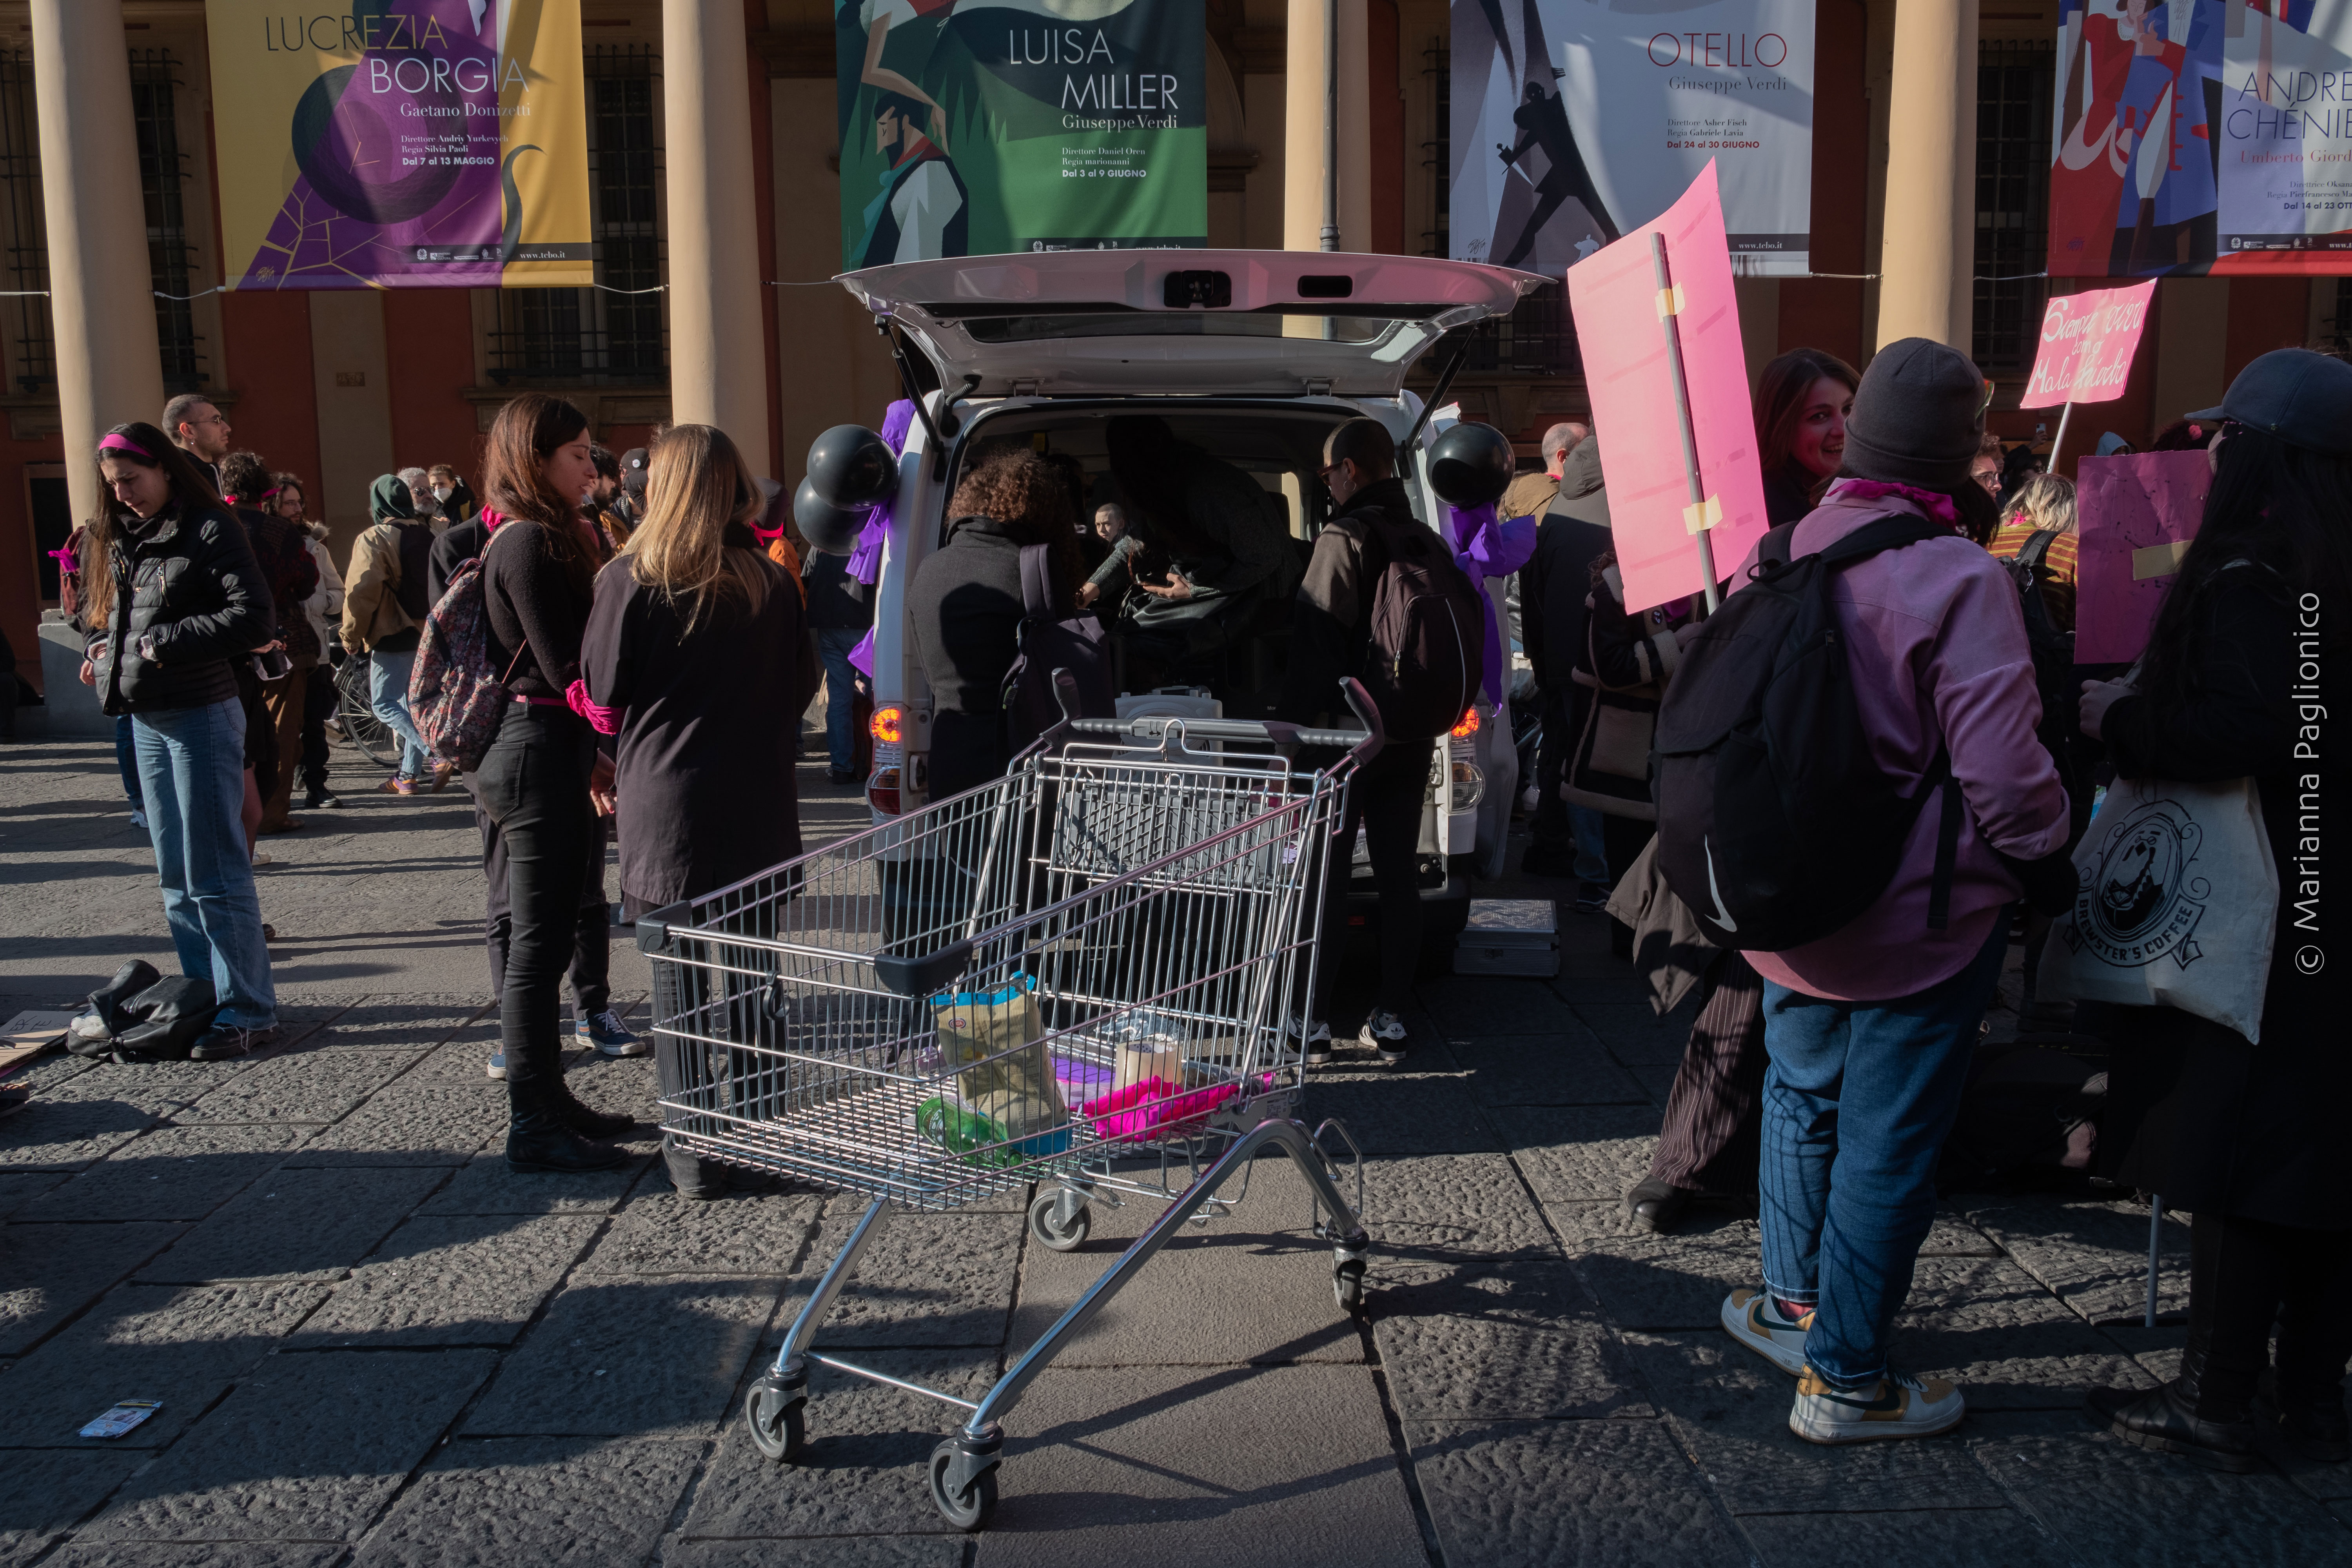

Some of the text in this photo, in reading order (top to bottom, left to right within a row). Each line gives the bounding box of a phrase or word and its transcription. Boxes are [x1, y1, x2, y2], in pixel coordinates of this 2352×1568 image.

[265, 14, 448, 52] LUCREZIA
[1010, 29, 1114, 64] LUISA
[1648, 33, 1787, 67] OTELLO
[370, 57, 529, 93] BORGIA
[1061, 74, 1178, 109] MILLER
[1669, 76, 1787, 94] Giuseppe Verdi
[400, 102, 531, 117] Gaetano Donizetti
[1062, 114, 1178, 133] Giuseppe Verdi
[438, 134, 465, 144] Andriy
[466, 134, 508, 144] Yurkevych
[1668, 129, 1687, 138] Regia
[402, 145, 423, 155] Regia
[2241, 150, 2303, 163] Umberto
[1062, 158, 1083, 167] Regia
[1062, 169, 1077, 177] Dal
[1088, 169, 1096, 177] al
[2267, 191, 2287, 200] Regia
[520, 250, 566, 259] www.tcbo.it
[2026, 356, 2072, 394] Mala
[2078, 898, 2192, 960] BREWSTER'S COFFEE
